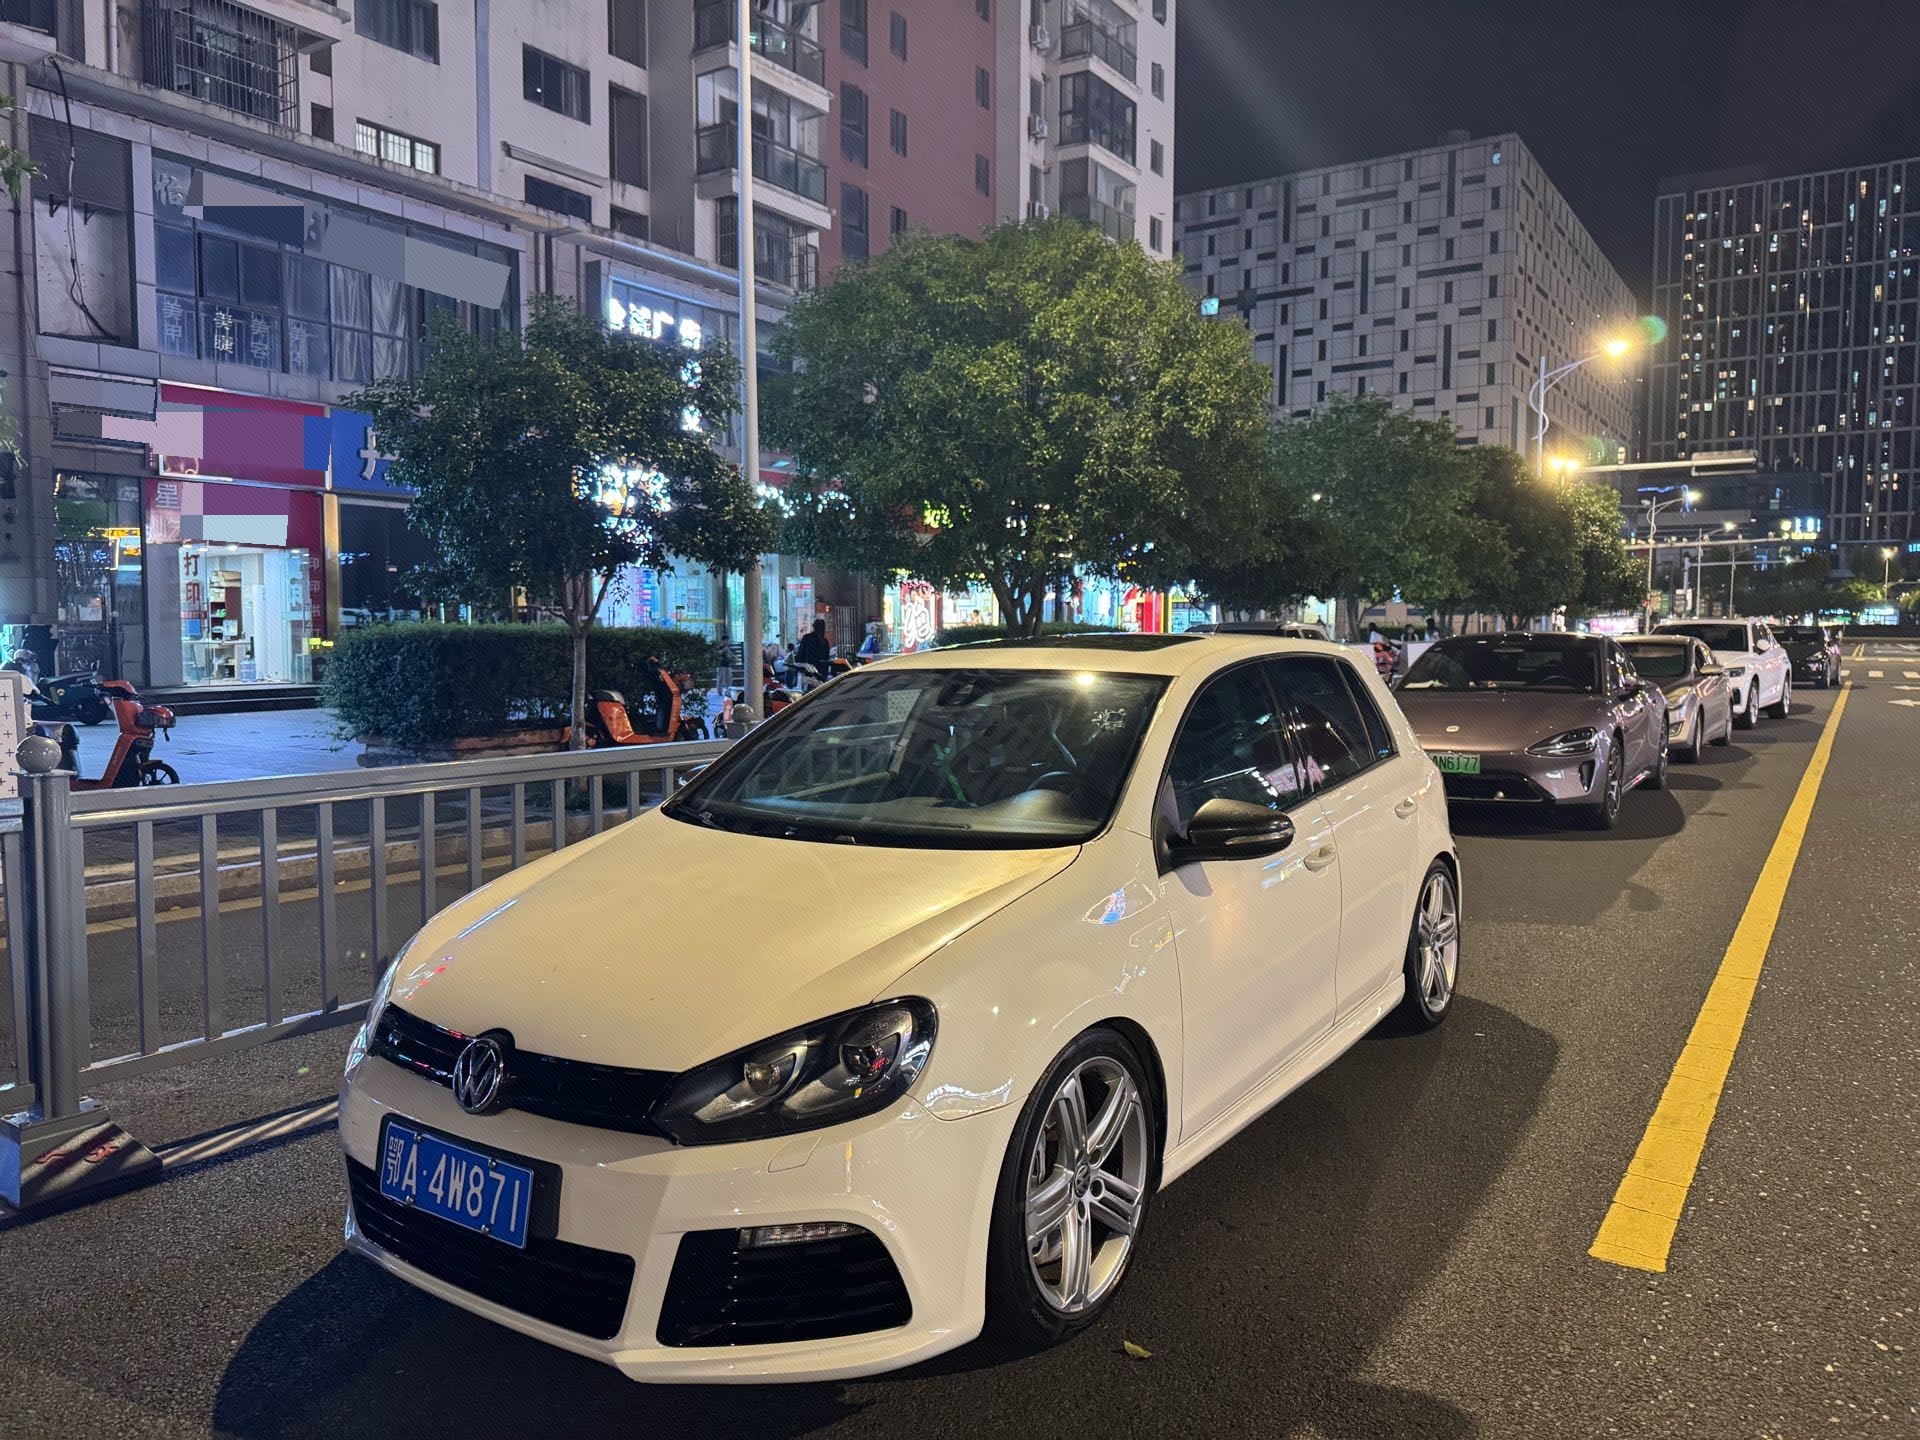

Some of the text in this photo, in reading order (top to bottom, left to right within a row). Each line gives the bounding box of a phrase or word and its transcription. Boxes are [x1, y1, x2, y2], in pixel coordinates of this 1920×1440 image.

[162, 299, 183, 343] 美甲
[214, 310, 234, 354] 美睫
[251, 317, 270, 360] 美容
[183, 551, 202, 605] 打印
